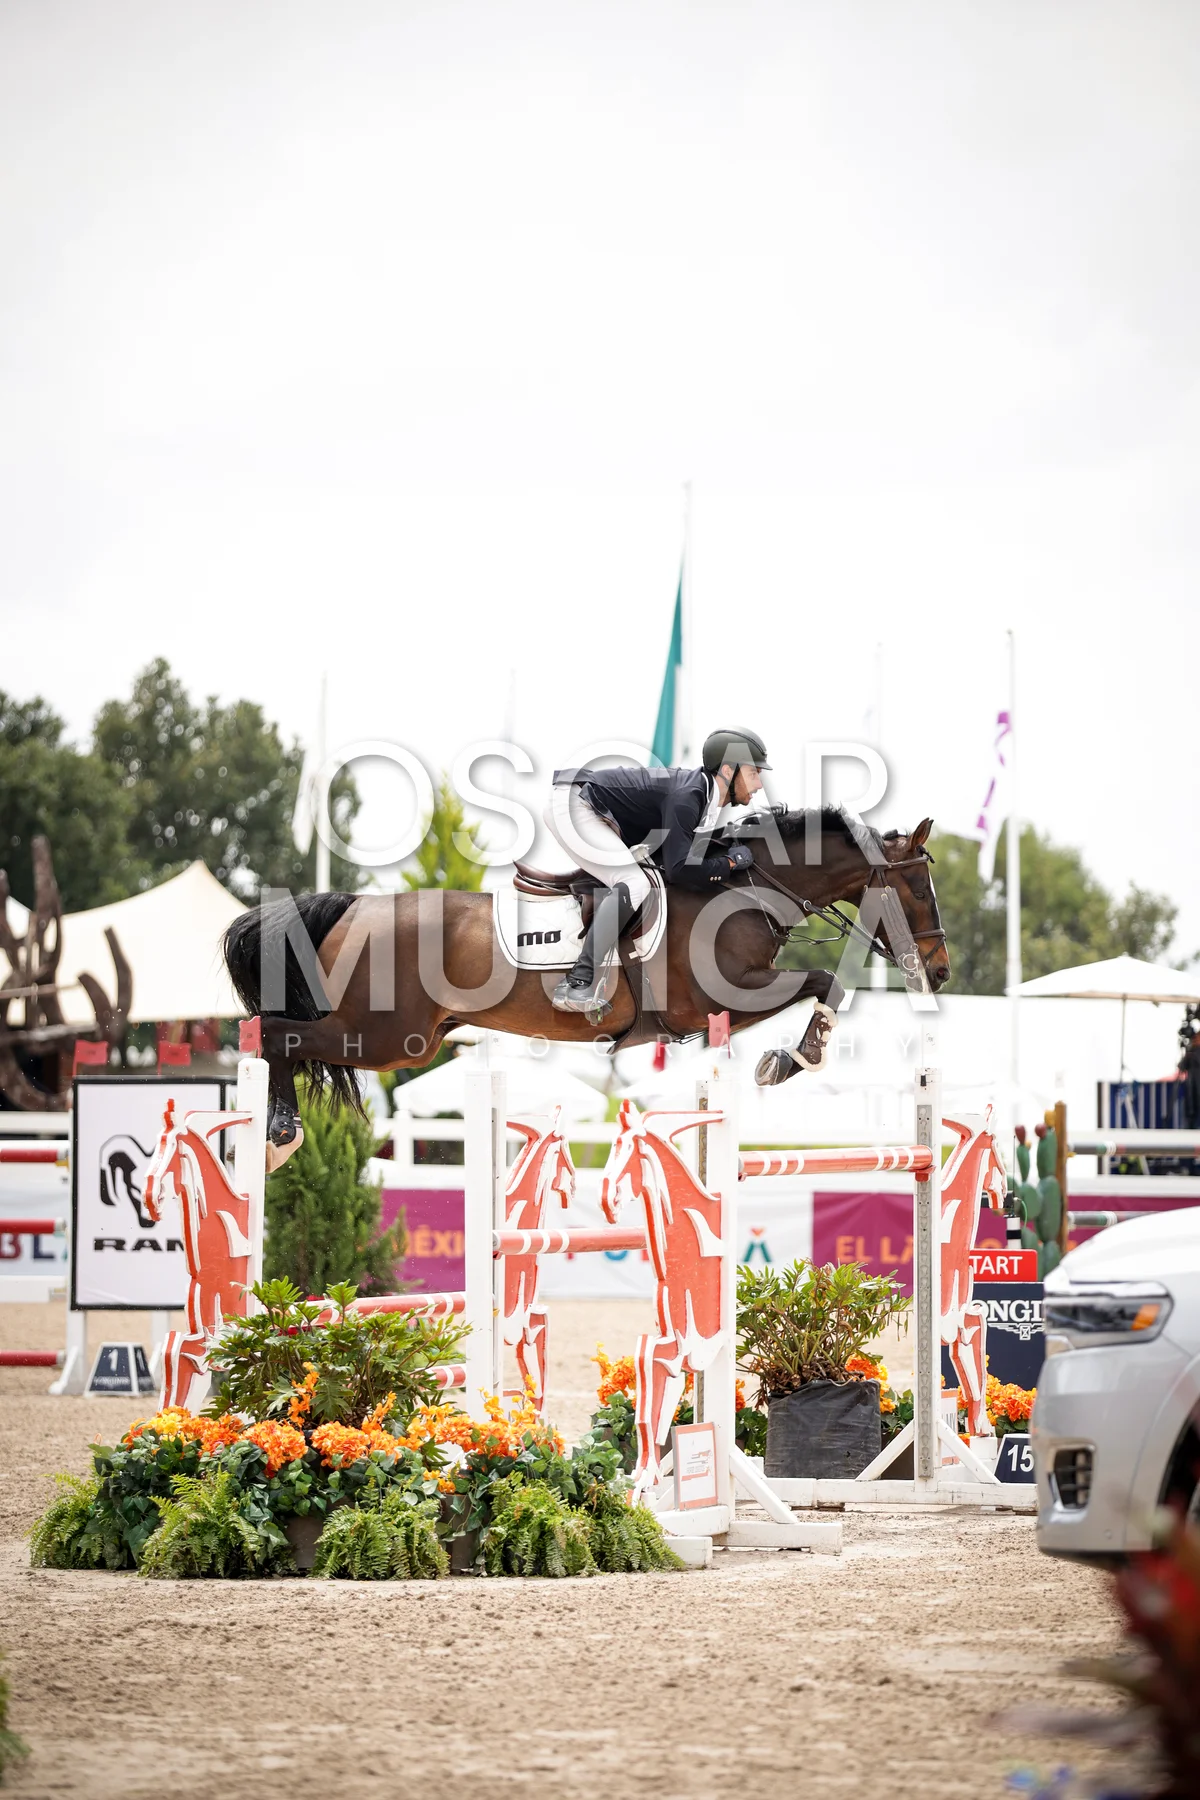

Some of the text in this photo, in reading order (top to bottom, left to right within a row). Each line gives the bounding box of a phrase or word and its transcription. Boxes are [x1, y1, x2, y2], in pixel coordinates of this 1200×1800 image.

[391, 1225, 465, 1258] ÉXI
[969, 1256, 1023, 1275] TART
[971, 1299, 1043, 1322] ONGI
[108, 1349, 118, 1371] 1
[1007, 1444, 1035, 1472] 15
